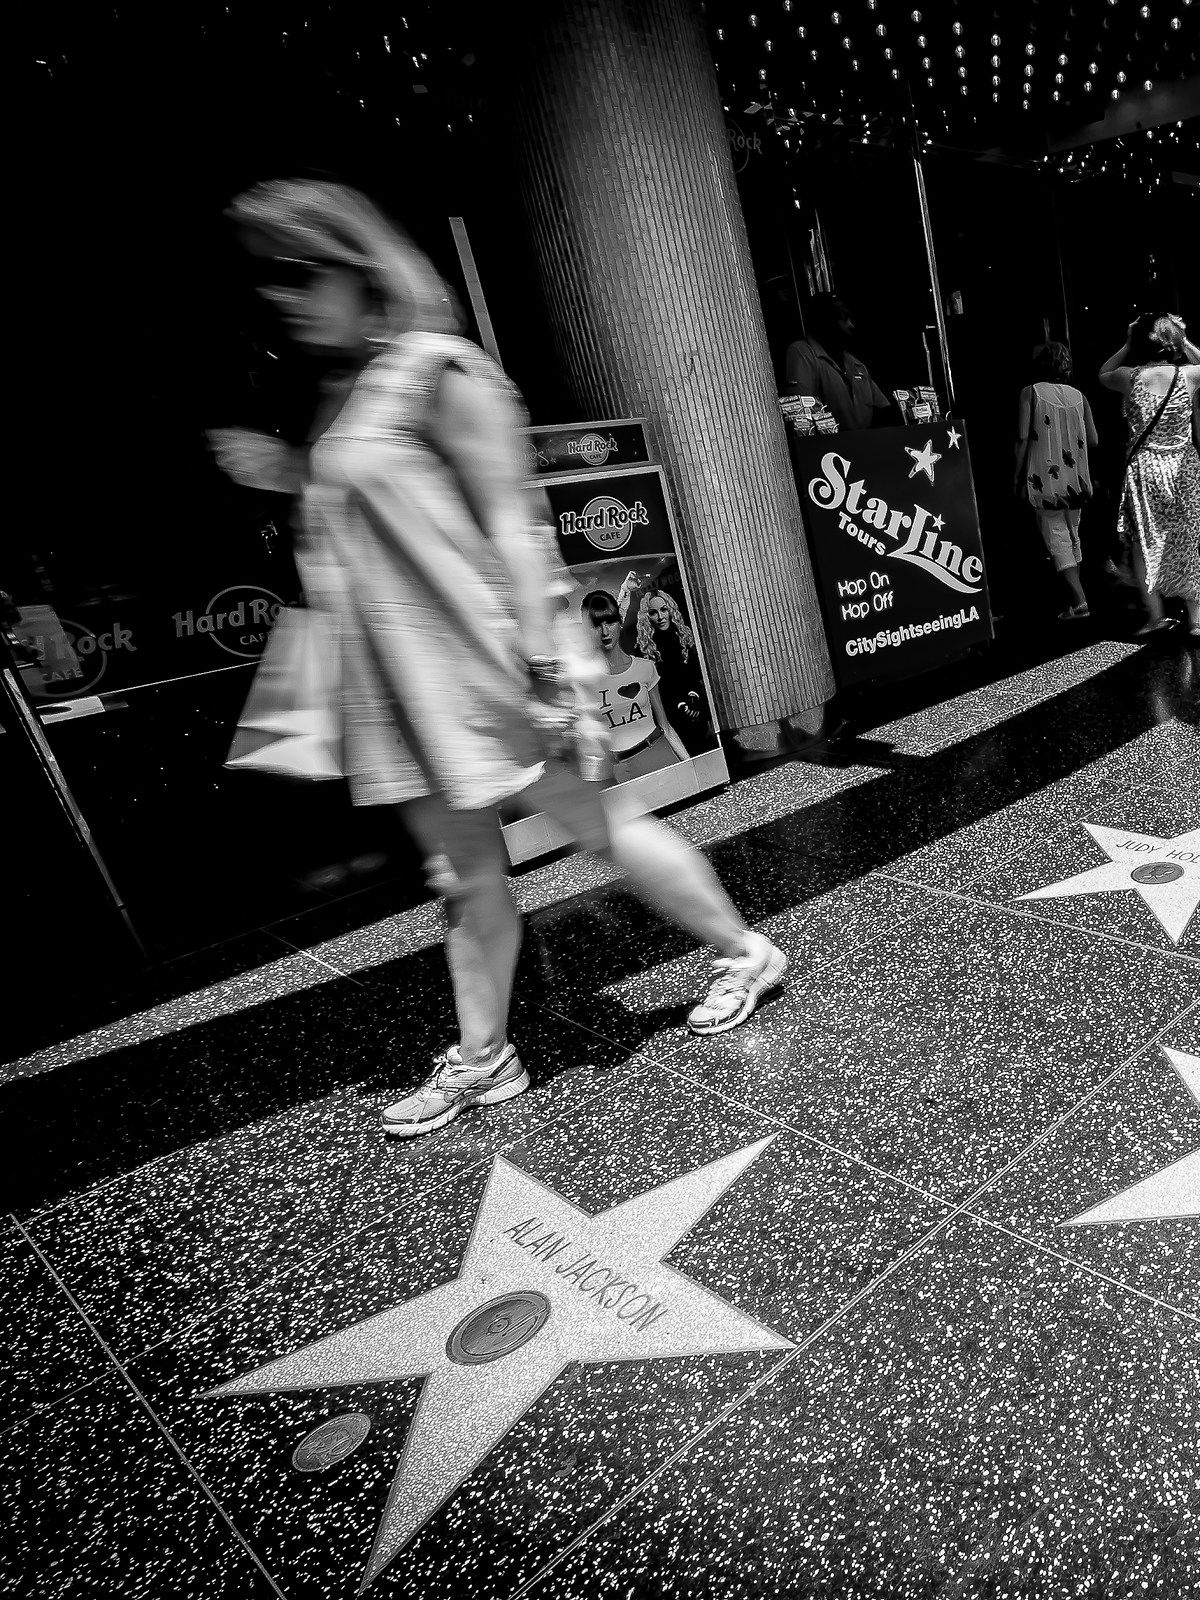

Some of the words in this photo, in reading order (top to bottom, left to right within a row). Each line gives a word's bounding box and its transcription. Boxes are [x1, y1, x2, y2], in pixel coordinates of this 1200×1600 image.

[567, 441, 593, 455] Hard
[594, 437, 618, 453] Rock
[559, 507, 606, 535] Hard
[606, 501, 650, 530] Rock
[808, 452, 983, 593] StarLine
[600, 531, 622, 541] CAFE
[838, 511, 887, 556] Tours
[838, 578, 867, 597] Hop
[870, 571, 890, 590] On
[172, 602, 245, 638] Hard
[250, 599, 288, 628] Ro
[842, 602, 870, 620] Hop
[873, 591, 894, 611] Off
[845, 605, 980, 657] CitySightseeingLA
[599, 689, 612, 709] I
[602, 702, 648, 729] LA
[1116, 840, 1163, 854] JUDY
[503, 1217, 571, 1262] ALAN
[555, 1253, 668, 1333] JACKSON
